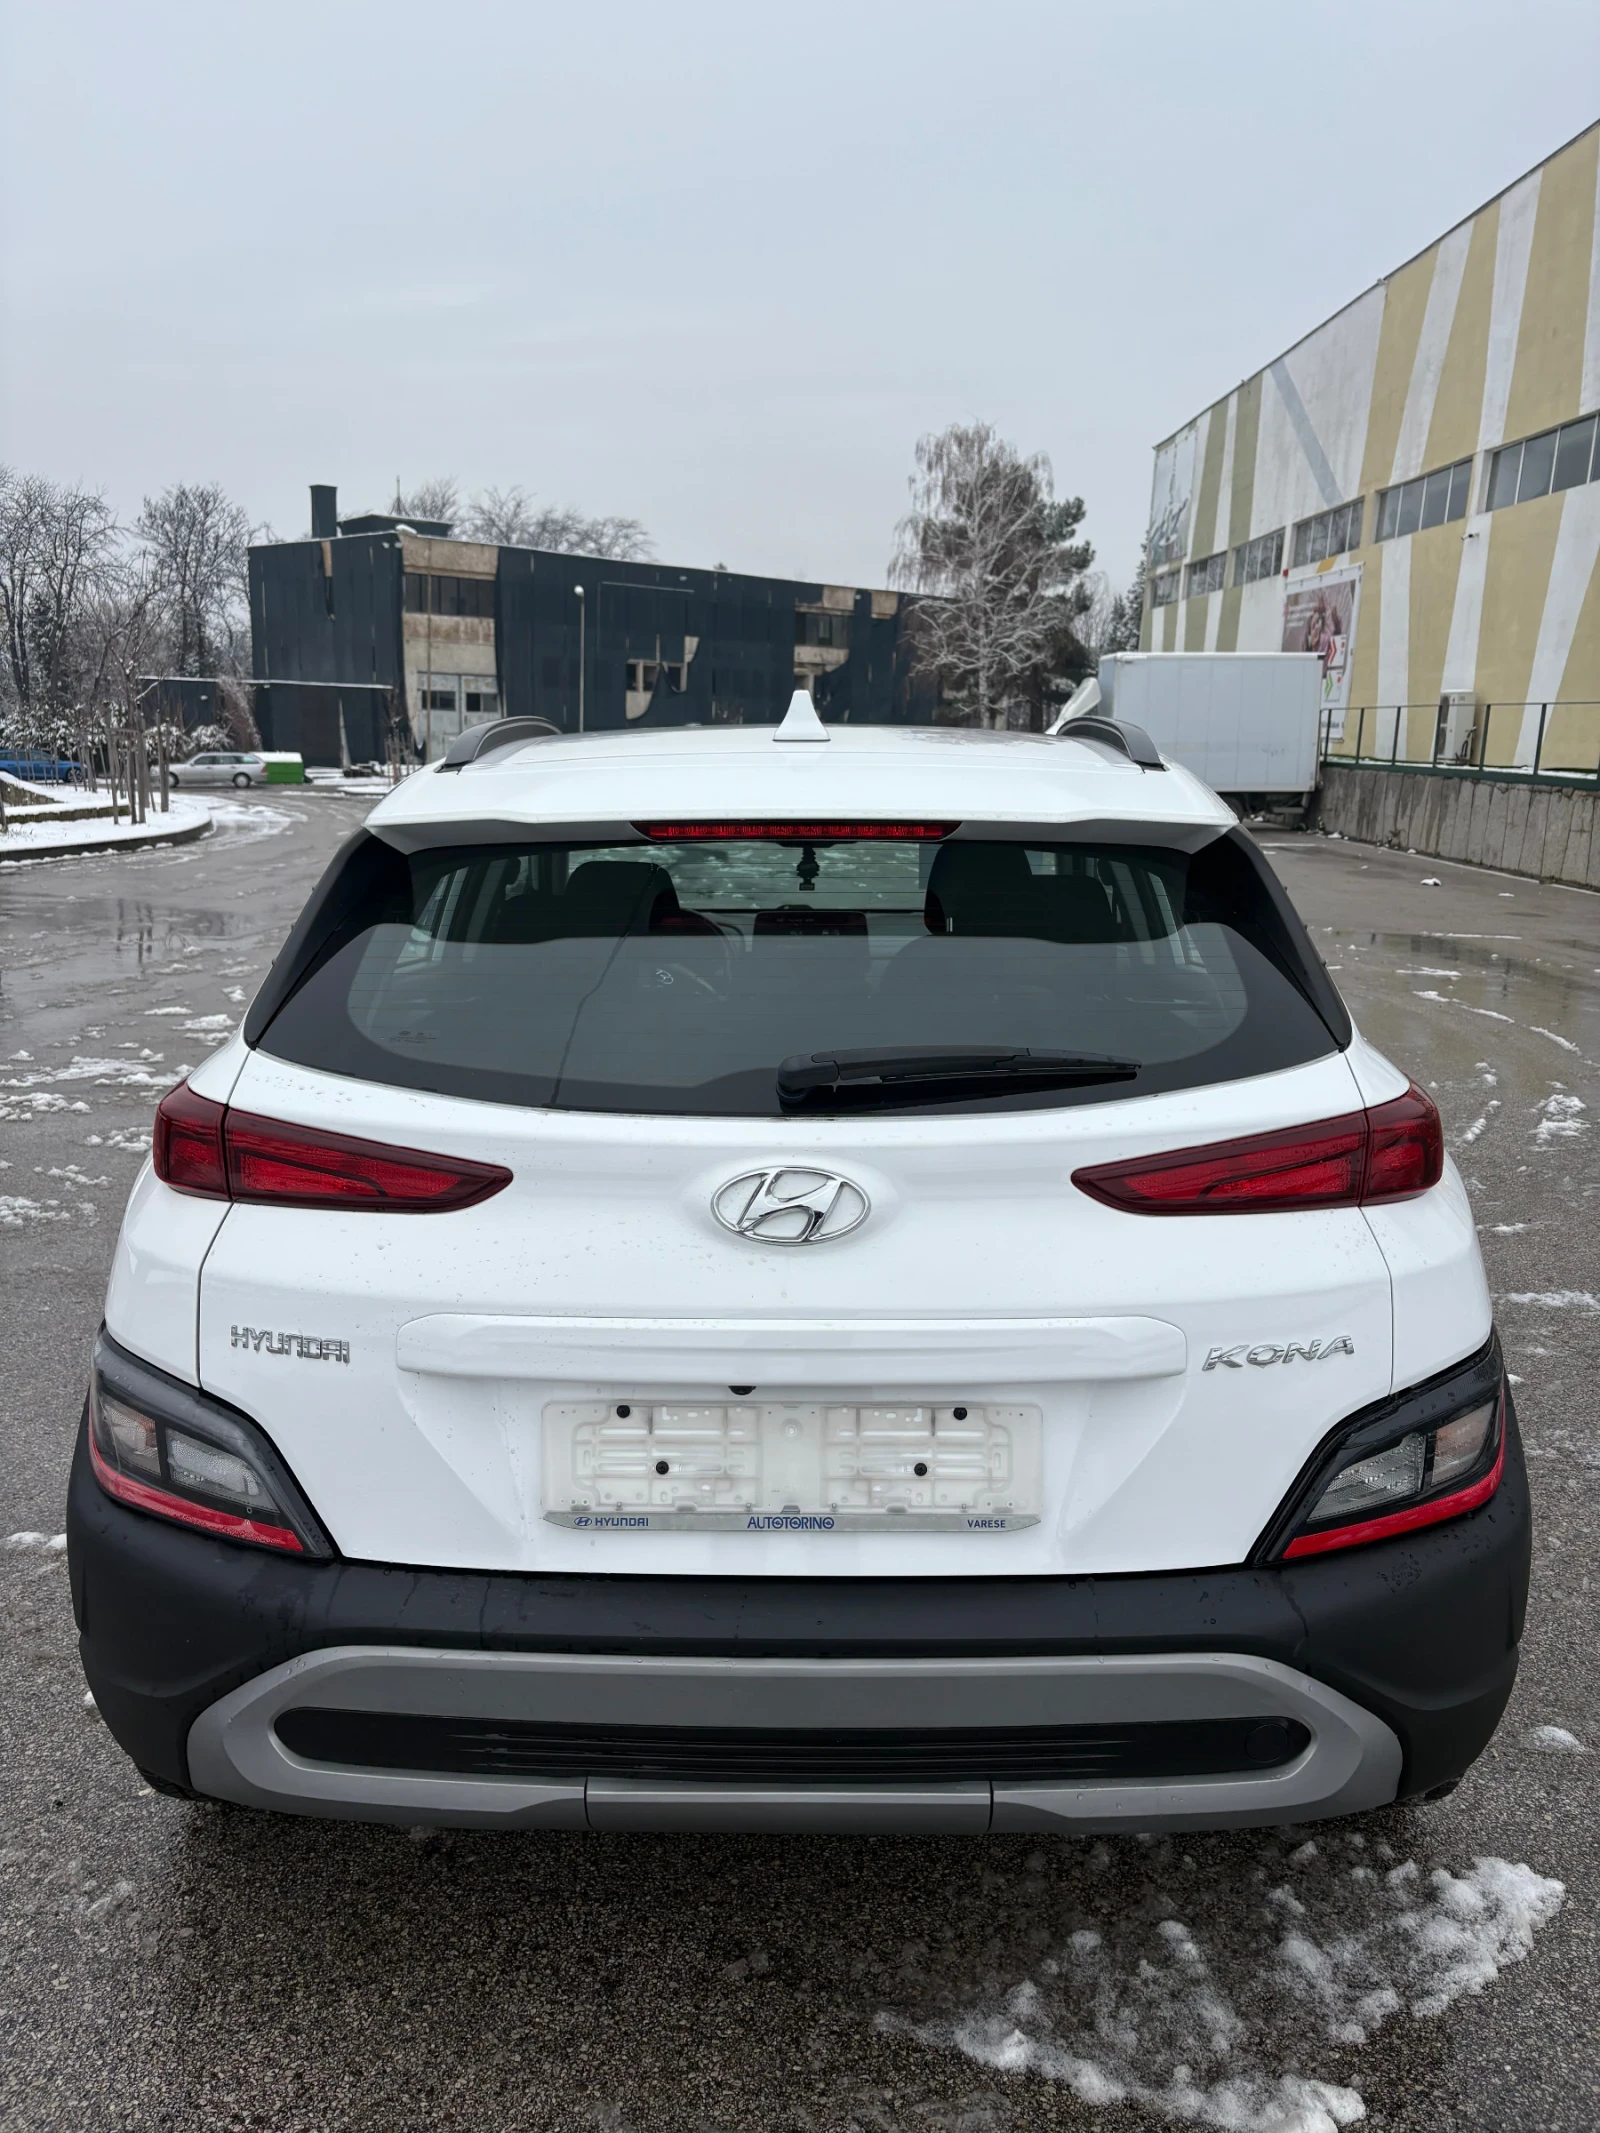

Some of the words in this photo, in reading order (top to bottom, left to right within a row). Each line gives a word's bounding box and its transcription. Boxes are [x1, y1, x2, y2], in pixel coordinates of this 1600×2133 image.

[230, 1325, 350, 1364] HYUNDAI
[1202, 1335, 1355, 1371] KONA
[595, 1517, 649, 1527] HYUNDAI
[747, 1516, 835, 1530] AUTOTORINO
[967, 1519, 1006, 1529] VARESE
